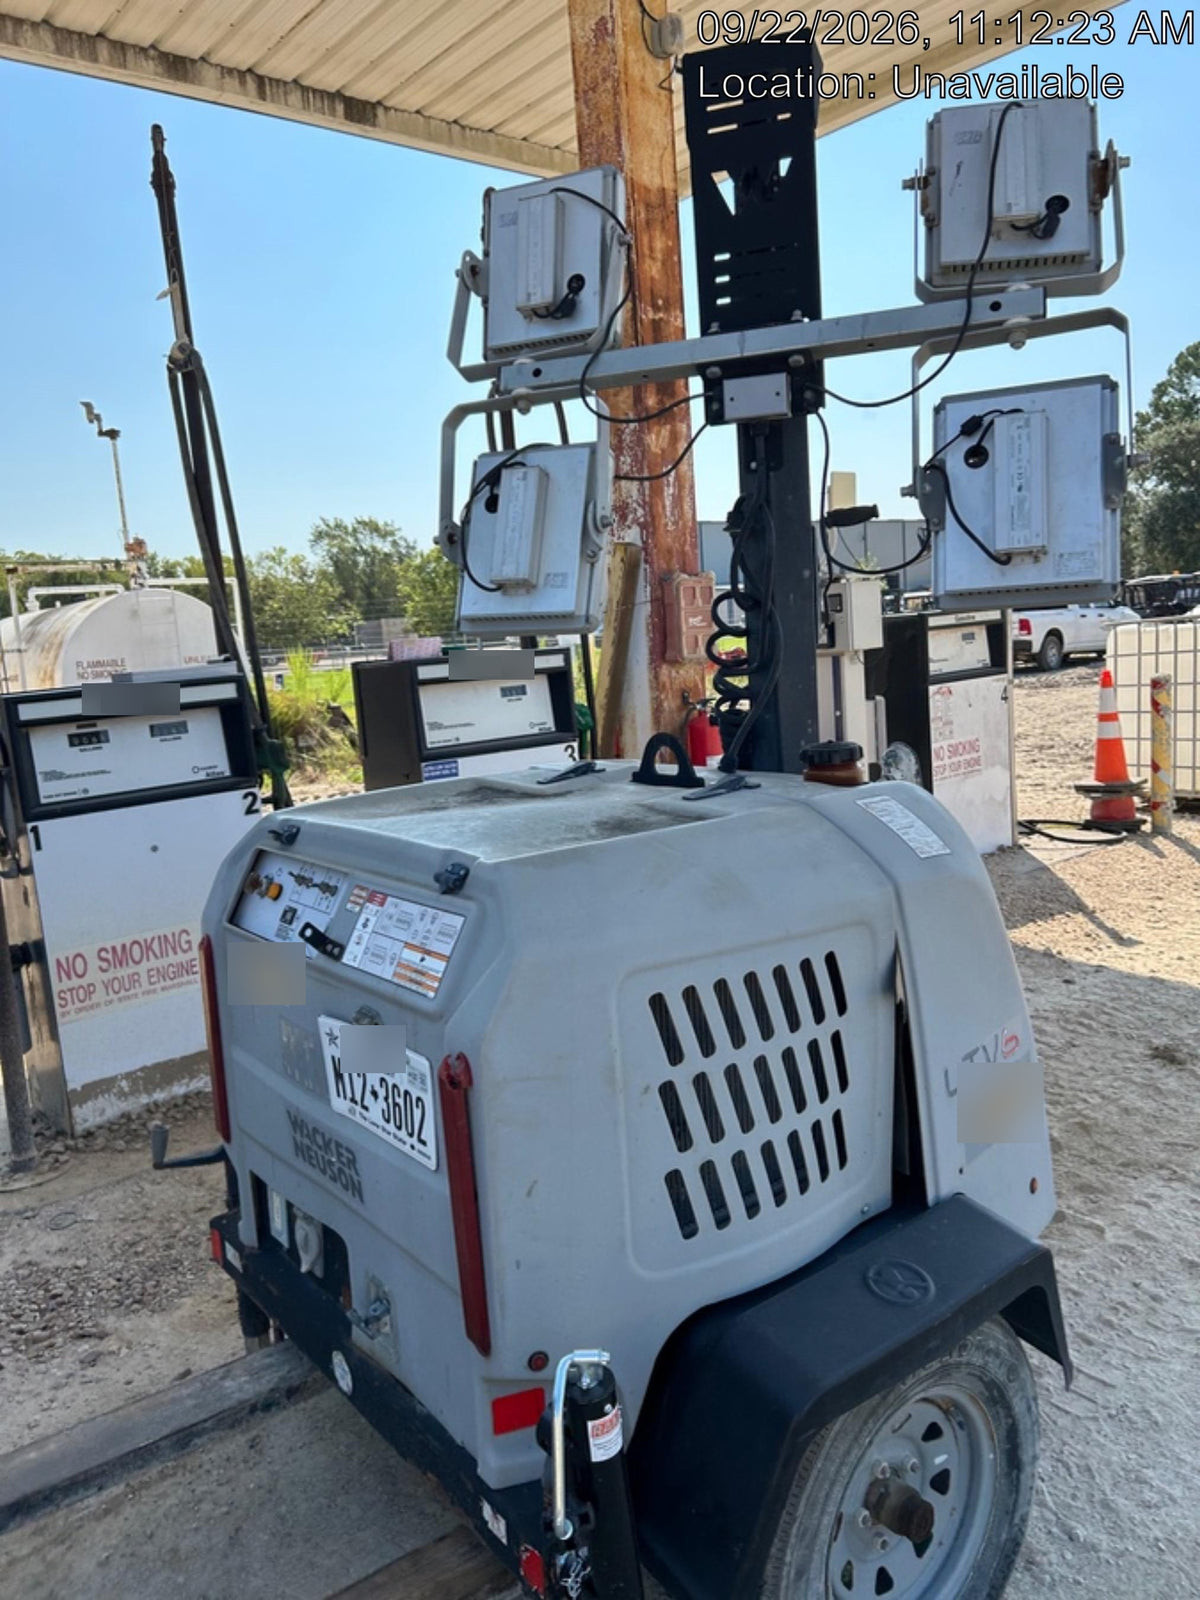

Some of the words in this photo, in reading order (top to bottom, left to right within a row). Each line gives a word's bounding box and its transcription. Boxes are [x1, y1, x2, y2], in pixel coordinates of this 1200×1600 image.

[75, 657, 126, 670] FLAMMABLE
[76, 671, 89, 680] NO
[1000, 686, 1009, 704] 4
[564, 744, 577, 762] 3
[934, 745, 945, 762] NO
[947, 737, 980, 760] SMOKING
[242, 791, 261, 816] 2
[29, 825, 43, 852] 1
[55, 952, 88, 983] NO
[97, 929, 193, 973] SMOKING
[57, 982, 97, 1009] STOP
[102, 971, 142, 996] YOUR
[147, 958, 199, 986] ENGINE
[286, 1110, 360, 1177] WACKER
[293, 1135, 365, 1204] NEUSON
